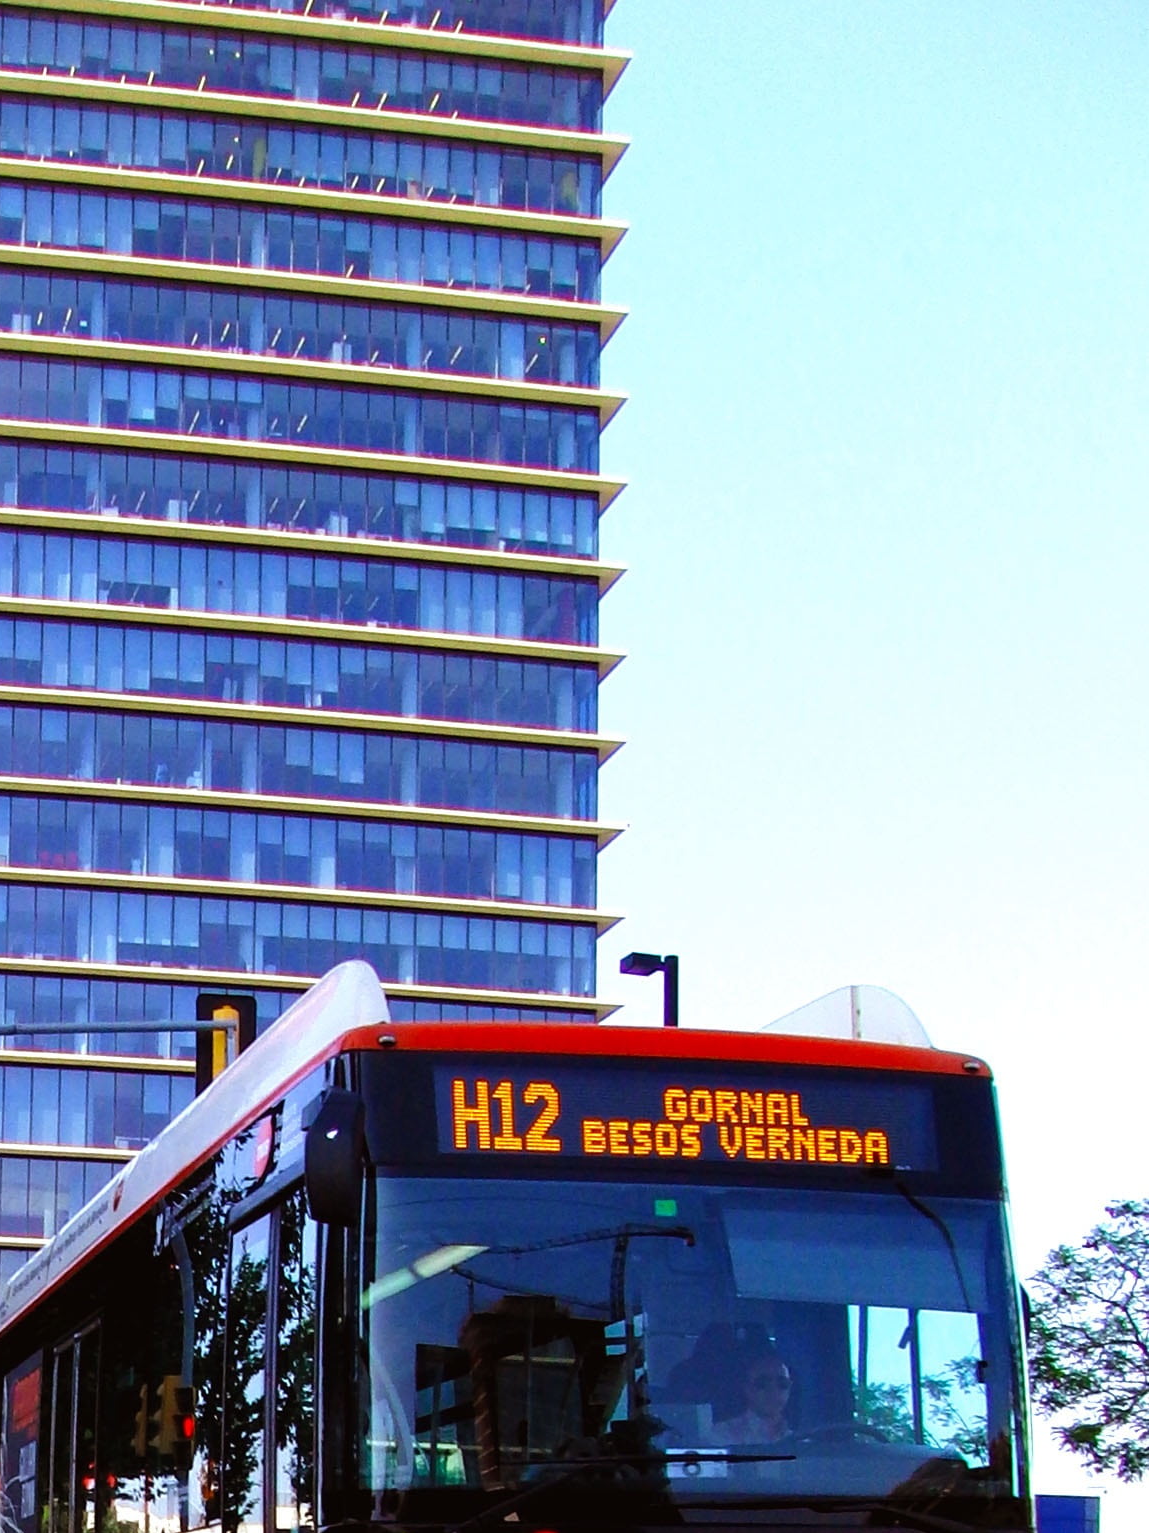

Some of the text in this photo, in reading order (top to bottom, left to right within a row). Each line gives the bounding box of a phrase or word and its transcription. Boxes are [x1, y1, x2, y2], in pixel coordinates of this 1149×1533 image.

[453, 1080, 561, 1151] H12
[664, 1089, 808, 1126] GORNAL
[583, 1121, 889, 1164] BESOS VERNEDA
